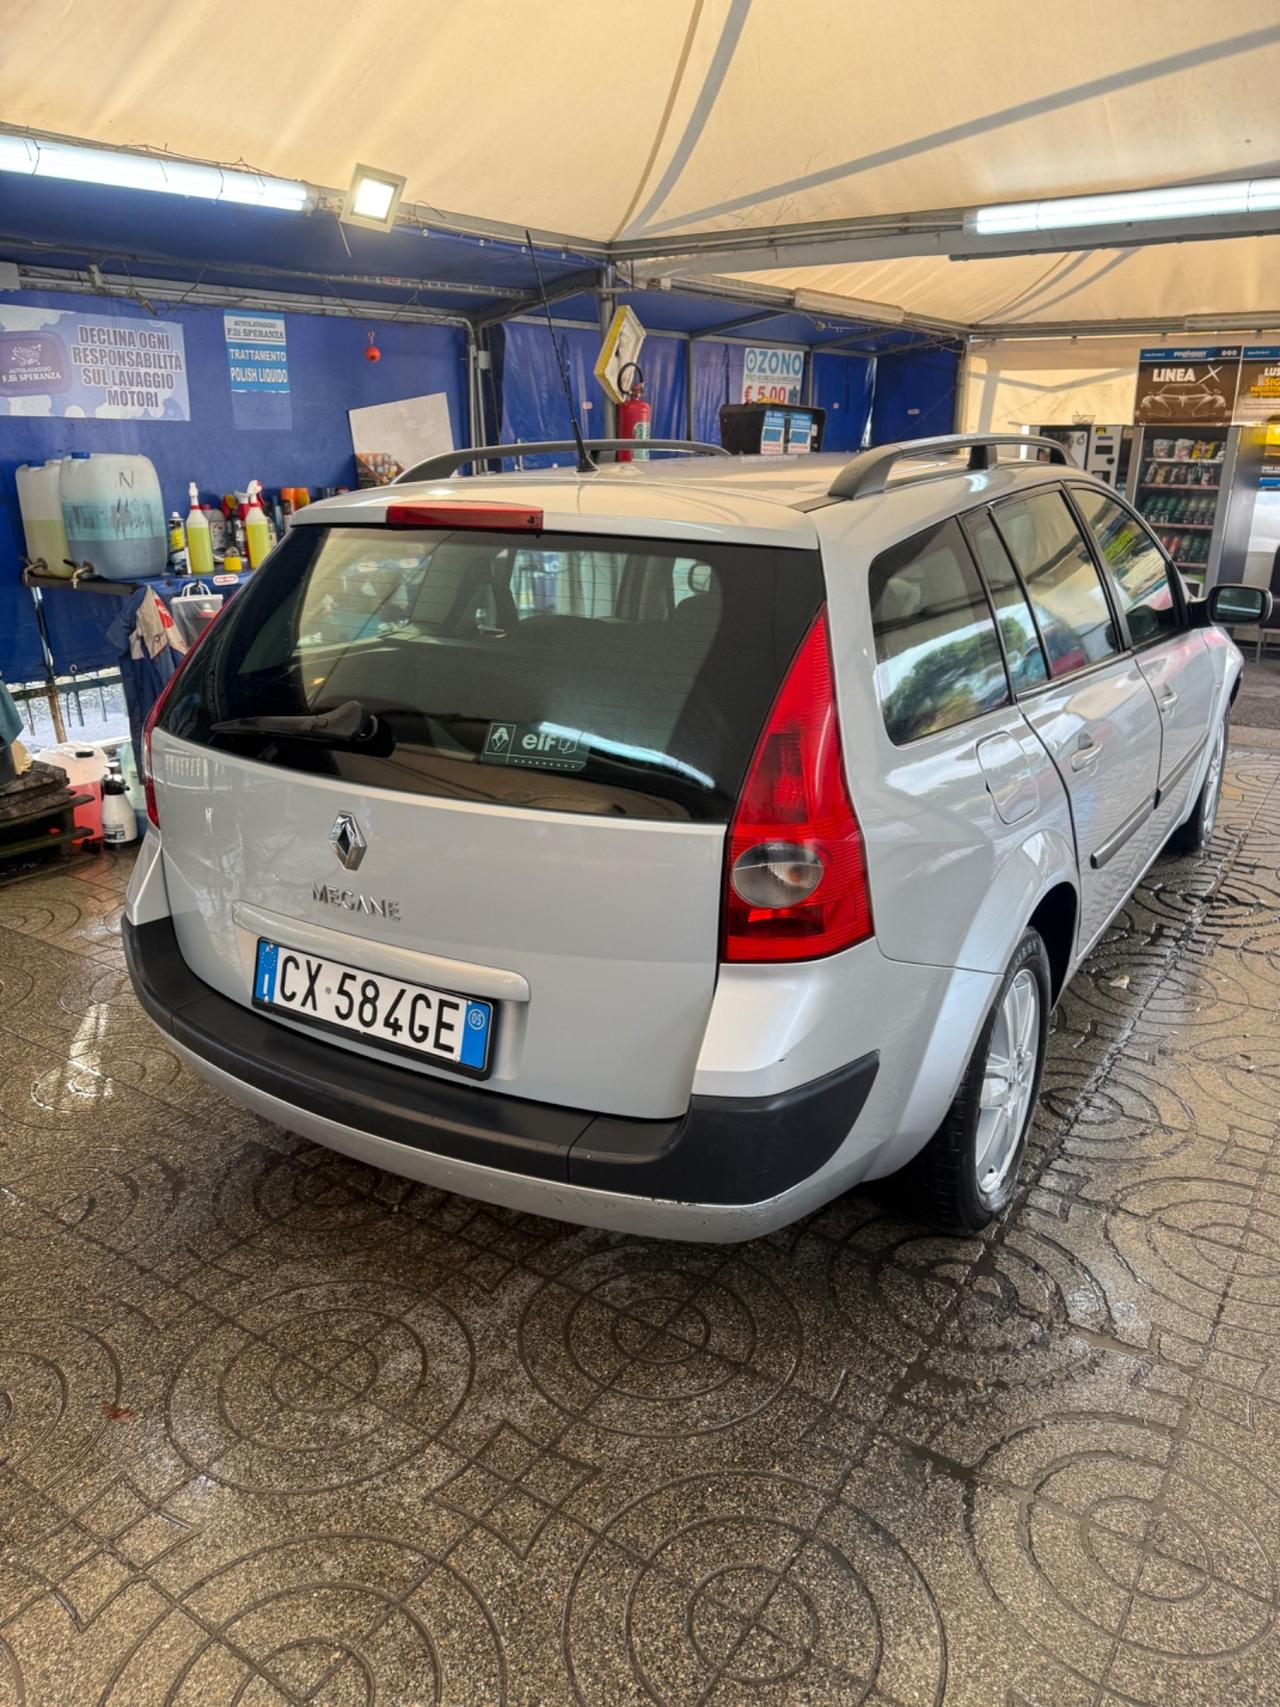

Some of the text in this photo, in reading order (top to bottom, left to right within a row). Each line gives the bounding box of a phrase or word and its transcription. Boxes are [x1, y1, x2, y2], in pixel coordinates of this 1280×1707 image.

[79, 326, 170, 350] DECLINA OGNI
[242, 328, 285, 339] SPERANZA
[72, 346, 182, 370] RESPONSABILITÀ
[229, 348, 287, 362] TRATTAMENTO
[745, 349, 802, 376] OZONO
[19, 371, 62, 382] SPERANZA
[82, 367, 174, 390] SUL LAVAGGIO
[230, 366, 288, 384] POLISH LIQUIDO
[1152, 364, 1223, 385] LINEA X
[107, 389, 160, 408] MOTORI
[312, 883, 401, 920] MEGANE
[279, 955, 460, 1054] CX 584GE
